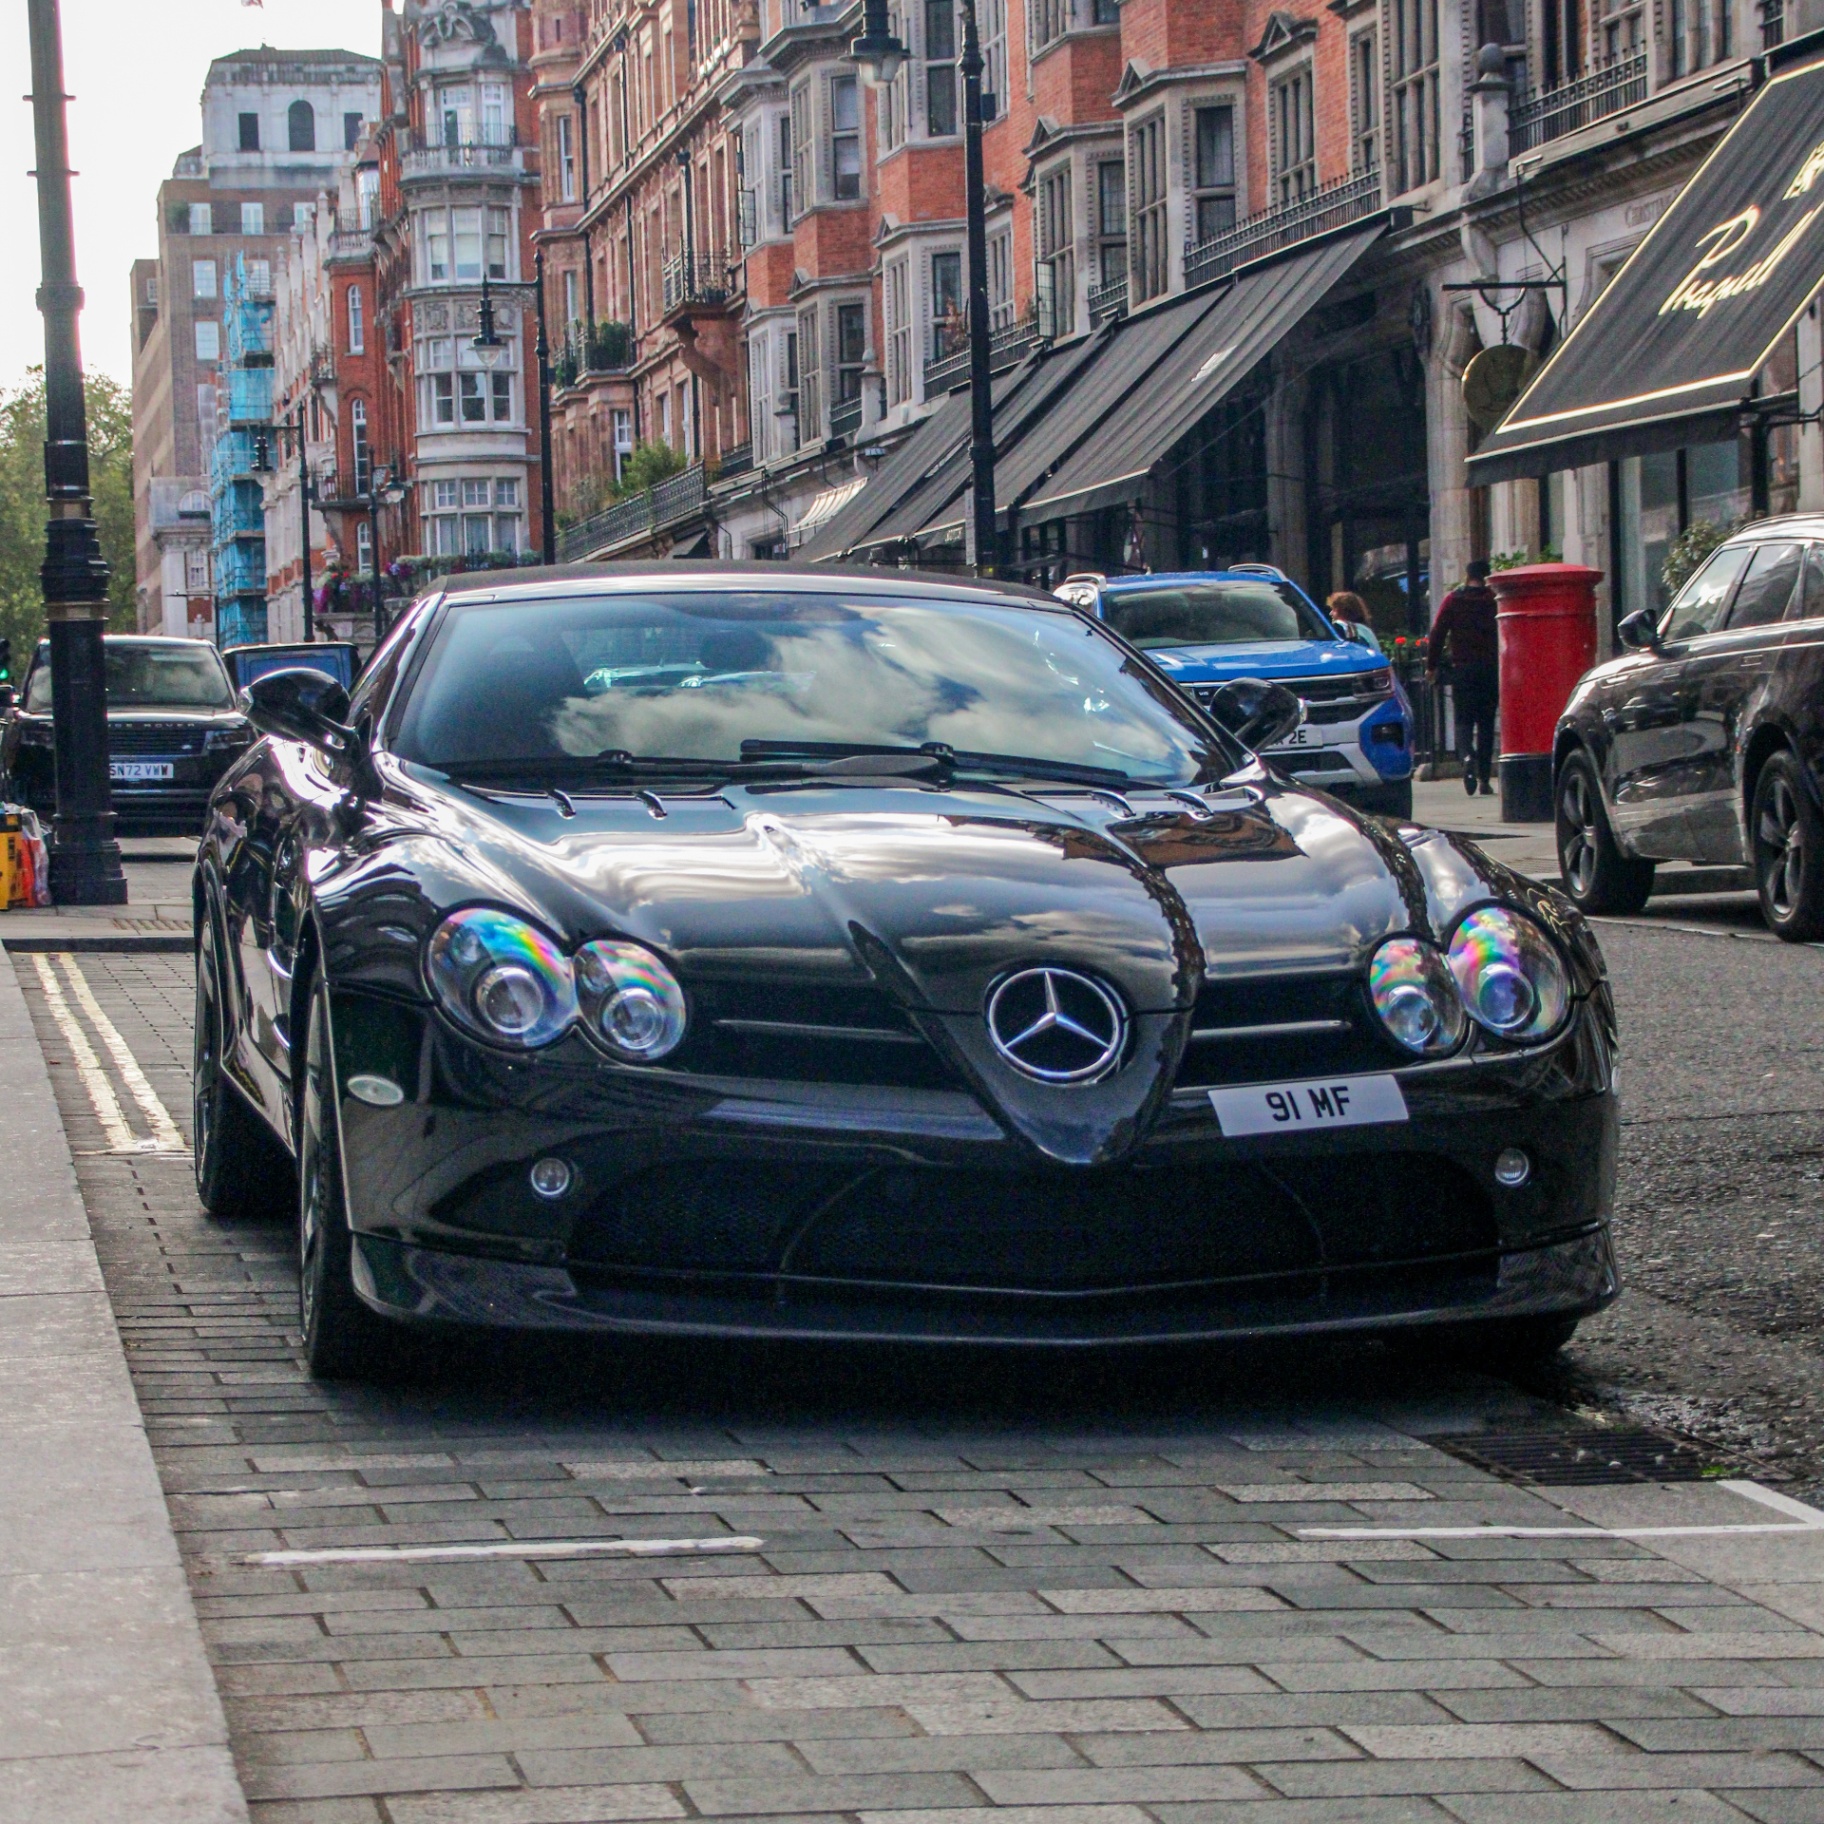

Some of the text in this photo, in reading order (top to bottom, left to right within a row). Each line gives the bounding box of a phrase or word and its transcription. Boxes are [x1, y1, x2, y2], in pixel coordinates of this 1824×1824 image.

[1658, 203, 1824, 320] Pragnell
[1265, 1086, 1350, 1122] 91 MF
